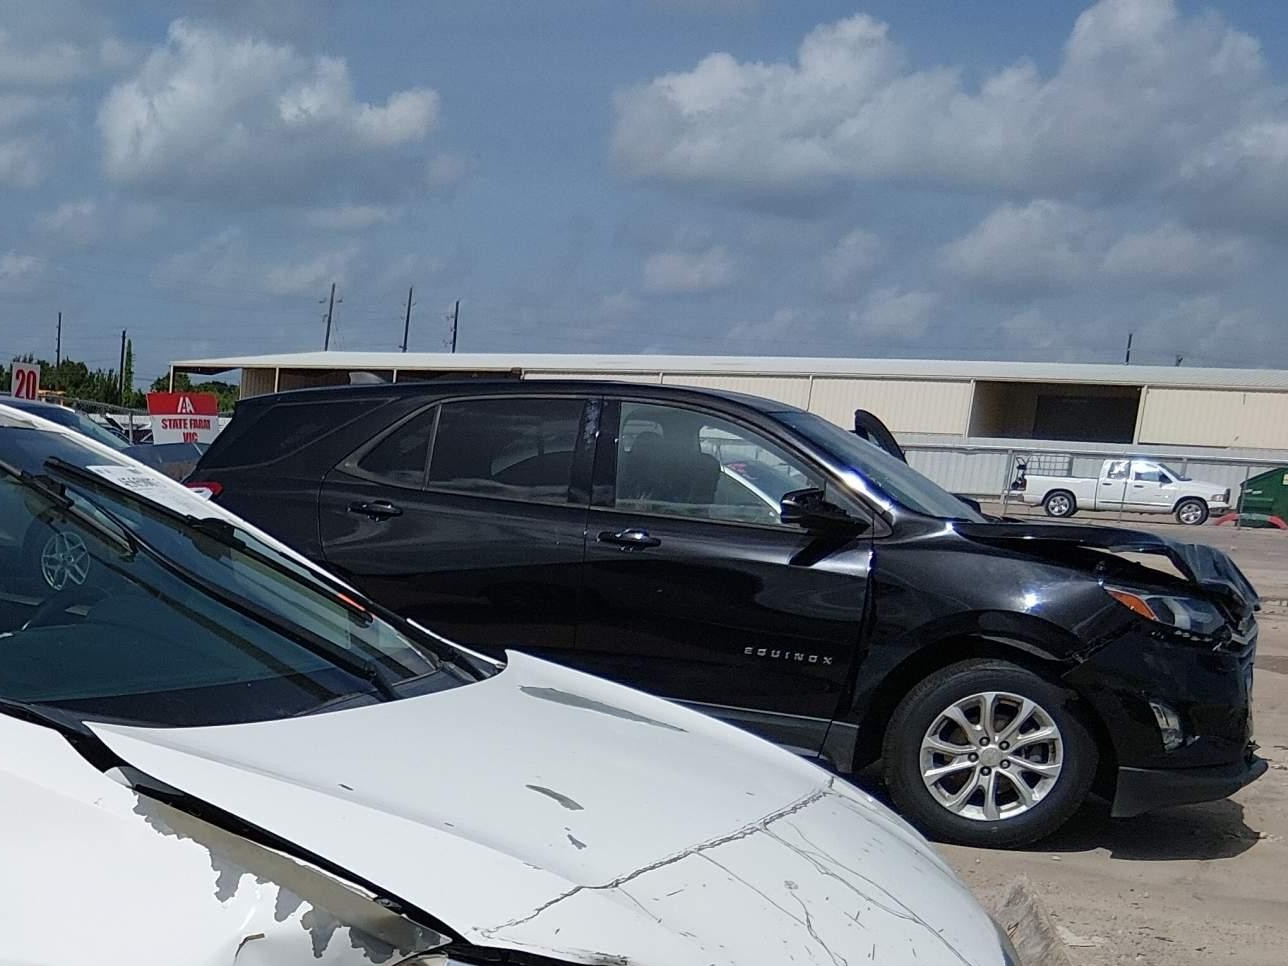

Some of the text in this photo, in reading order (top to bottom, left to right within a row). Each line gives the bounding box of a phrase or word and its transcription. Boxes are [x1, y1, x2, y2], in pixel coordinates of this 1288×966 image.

[15, 369, 37, 400] 20
[161, 418, 211, 430] STATE FARM
[183, 431, 199, 443] VIC
[744, 647, 832, 664] EQUINOX
